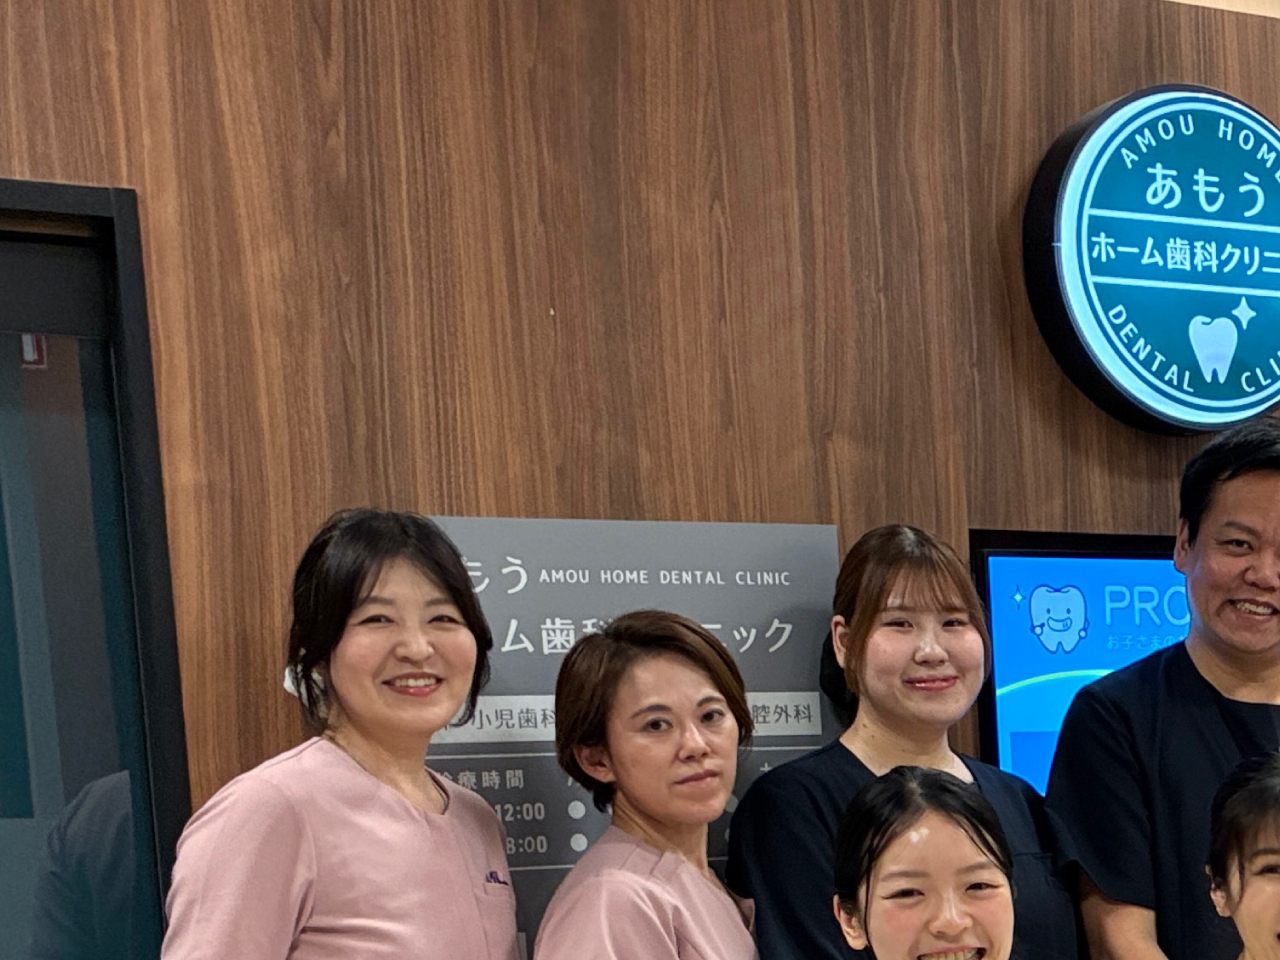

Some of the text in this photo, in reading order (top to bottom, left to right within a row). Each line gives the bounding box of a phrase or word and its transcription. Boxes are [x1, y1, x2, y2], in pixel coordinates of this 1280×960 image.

[1120, 114, 1195, 169] AMOU
[1146, 163, 1265, 217] あもう
[1108, 304, 1194, 393] DENTAL
[539, 569, 590, 584] AMOU
[600, 570, 649, 584] HOME
[660, 570, 726, 585] DENTAL
[735, 571, 791, 586] CLINIC
